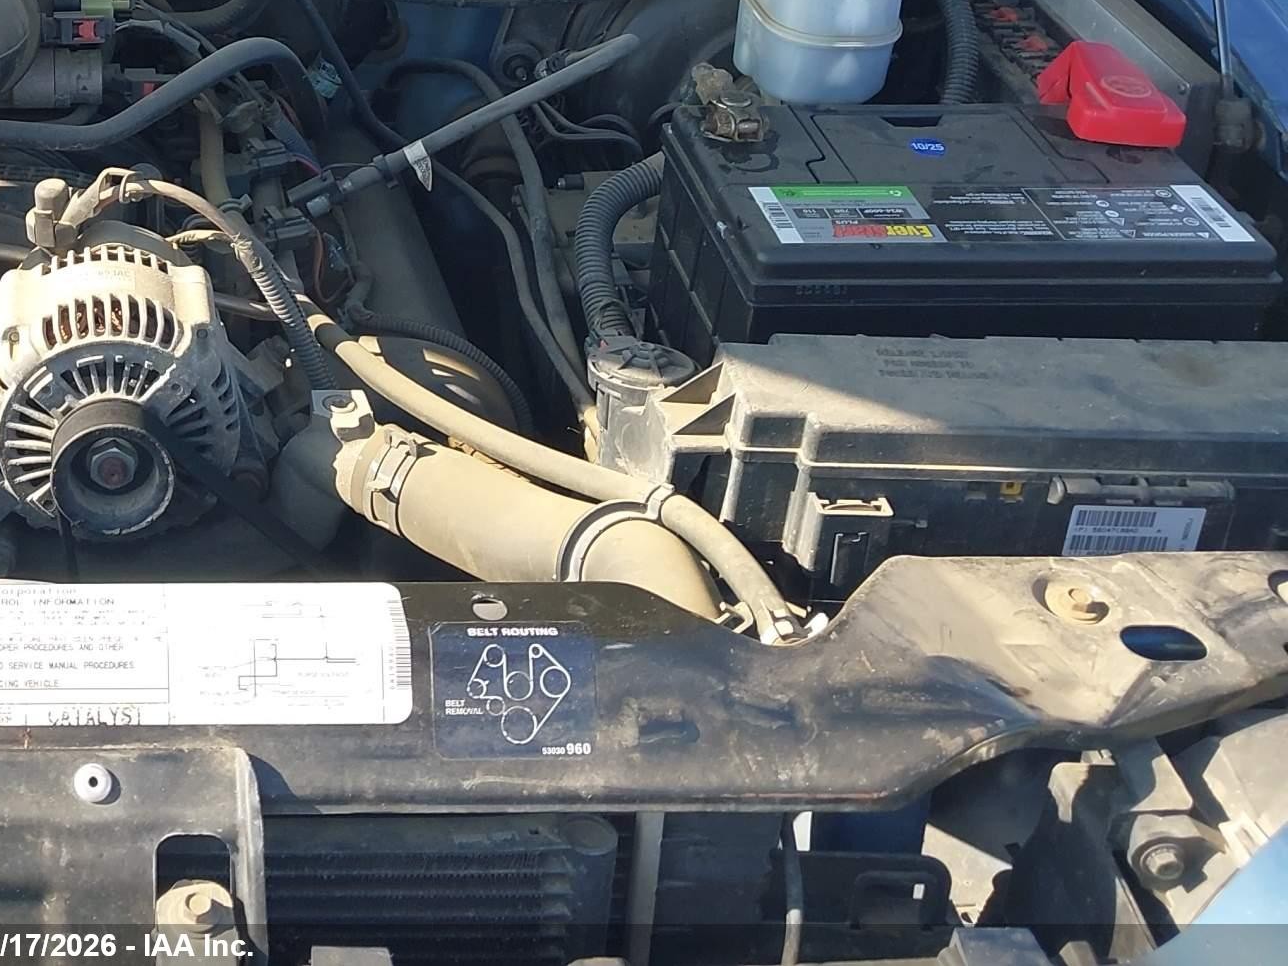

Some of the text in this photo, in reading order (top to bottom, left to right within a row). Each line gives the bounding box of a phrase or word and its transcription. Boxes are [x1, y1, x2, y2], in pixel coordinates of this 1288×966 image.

[912, 142, 944, 151] 10/25
[832, 224, 934, 239] EverStart
[33, 598, 115, 607] INFORMATION
[467, 627, 559, 636] BELT ROUTING
[48, 706, 141, 726] CATALYST
